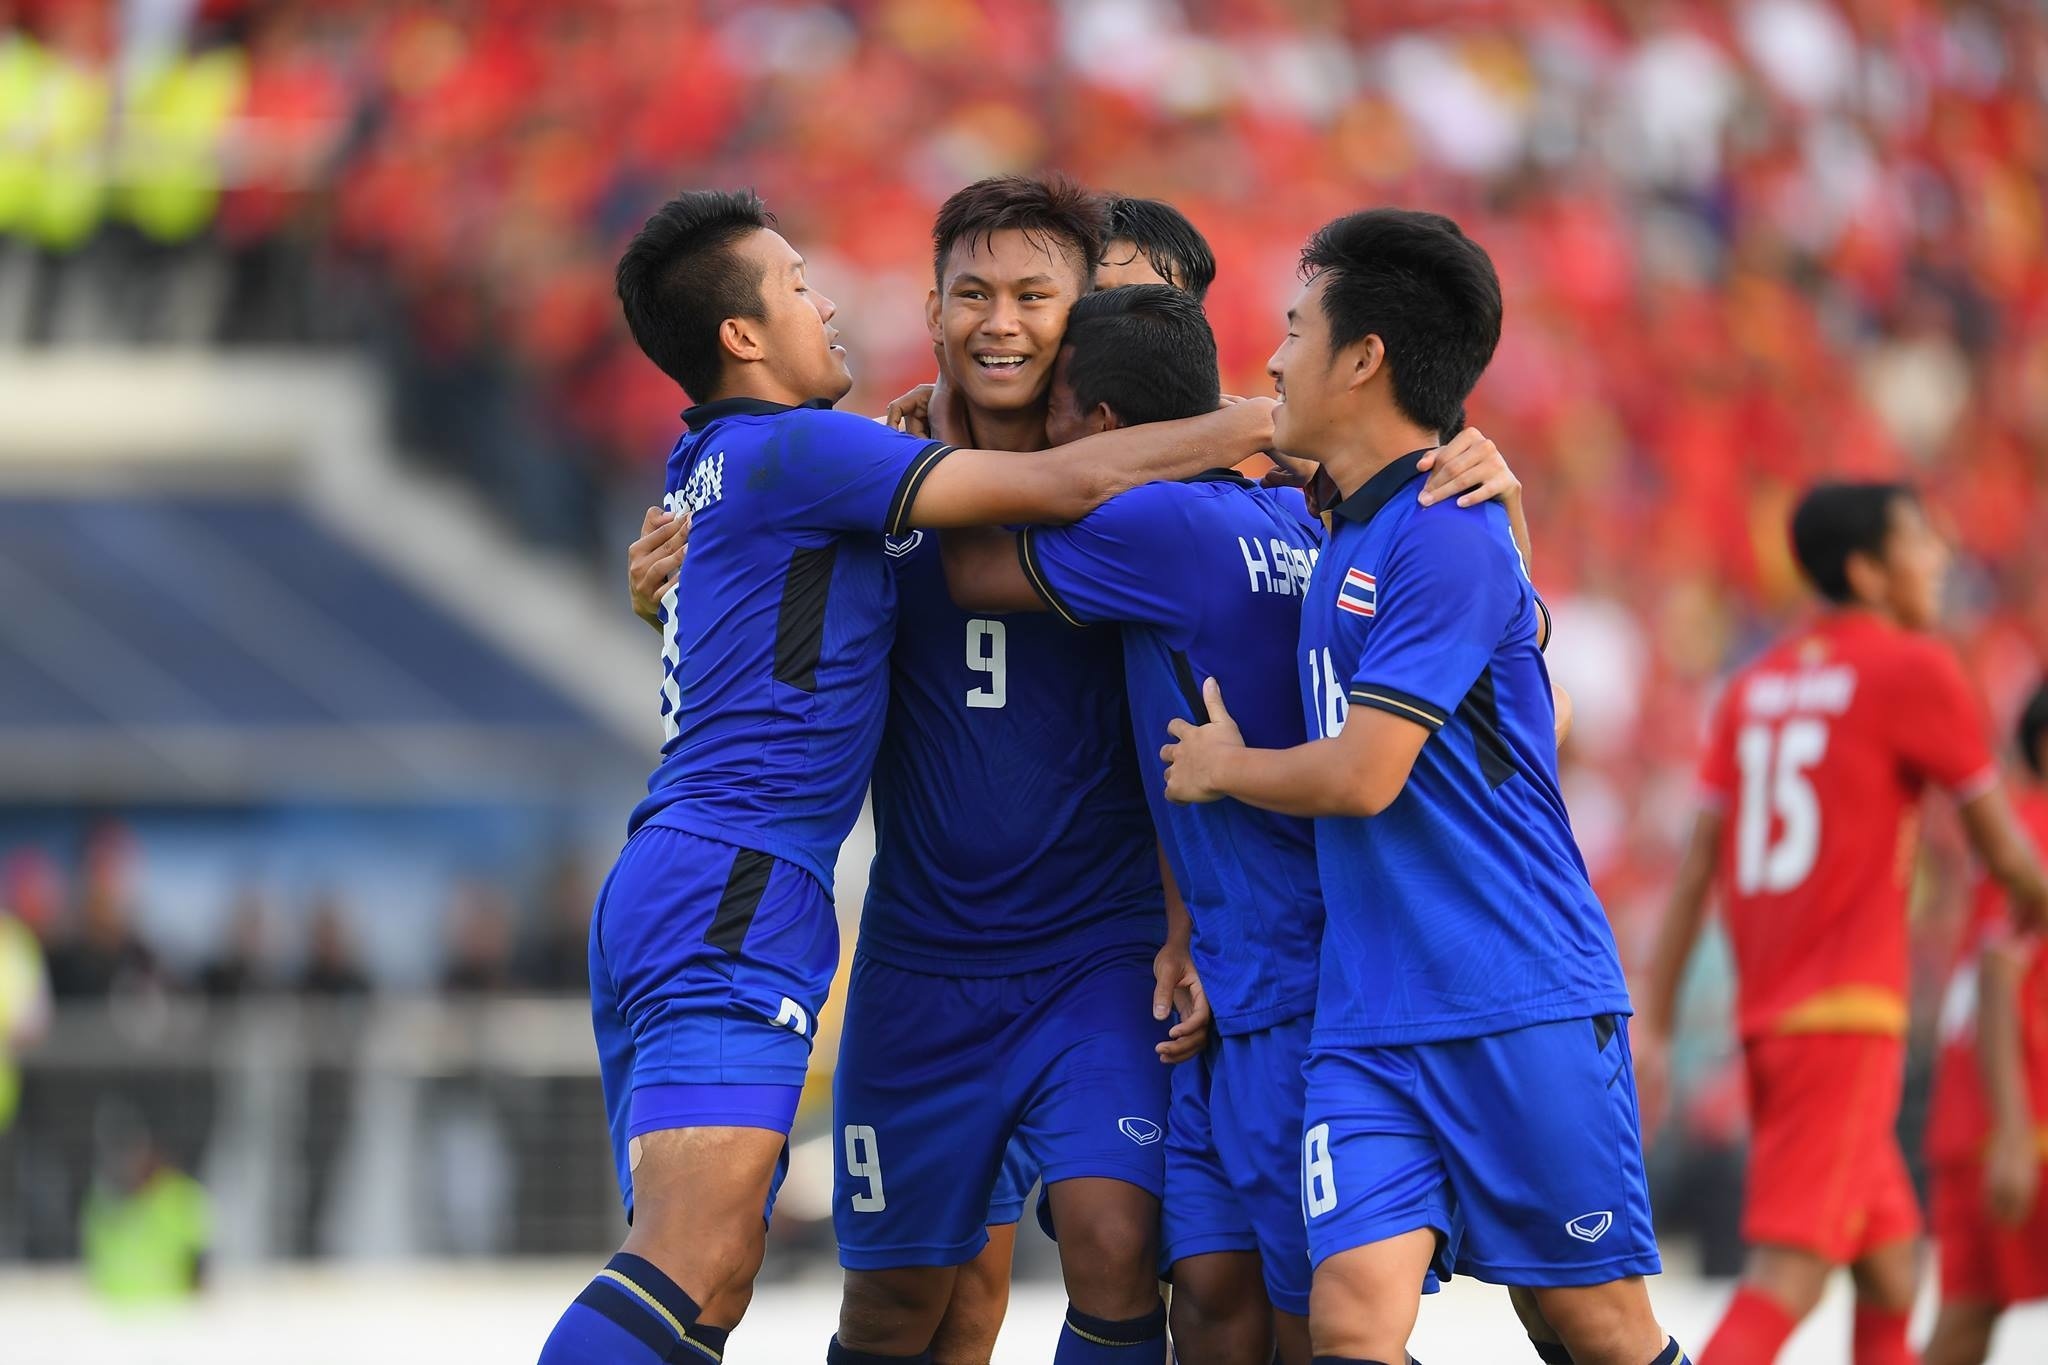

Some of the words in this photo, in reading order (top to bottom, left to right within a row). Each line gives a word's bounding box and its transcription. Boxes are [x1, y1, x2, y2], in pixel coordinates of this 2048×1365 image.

[966, 618, 1006, 709] 9
[1733, 717, 1829, 895] 15
[844, 1124, 887, 1213] 9
